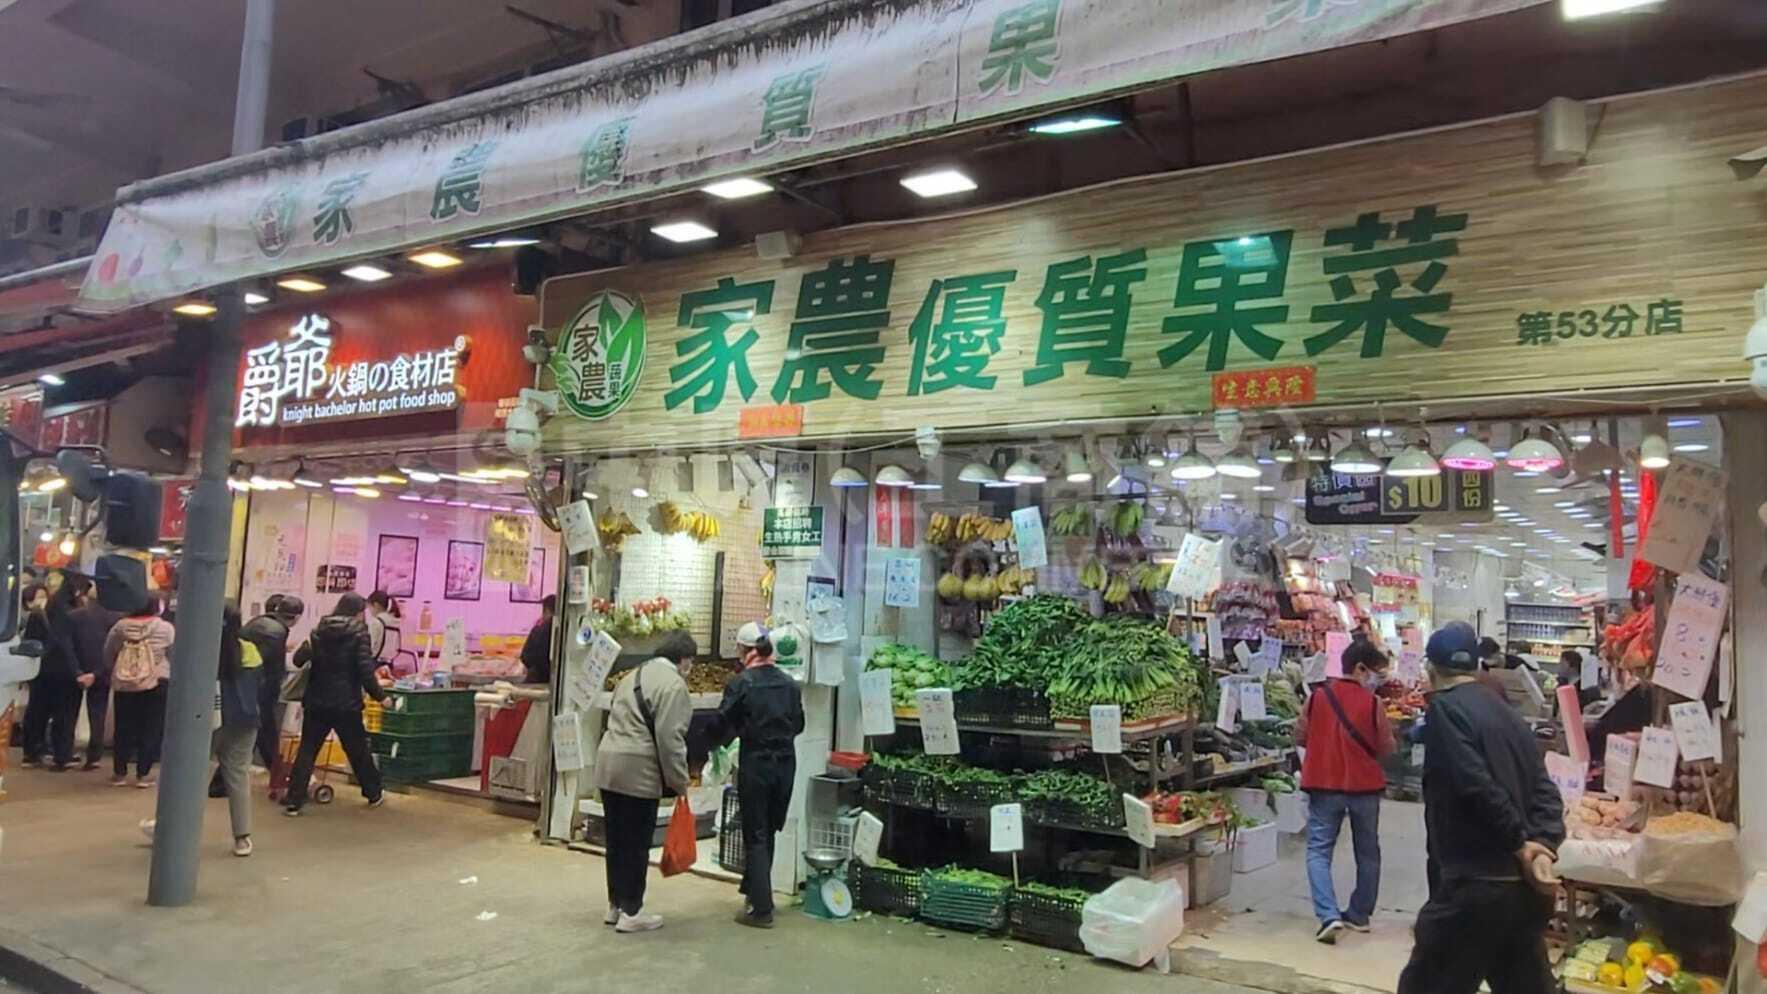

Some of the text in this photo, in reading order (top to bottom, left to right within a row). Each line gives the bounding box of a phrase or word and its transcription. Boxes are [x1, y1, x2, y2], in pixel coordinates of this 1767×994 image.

[663, 205, 1468, 415] 家農優質果菜
[1516, 299, 1684, 346] 第53分店
[235, 313, 331, 427] 爵爺
[326, 351, 457, 399] 火鍋の食材店
[571, 323, 606, 401] 家農
[283, 390, 455, 423] knight bachelor hot pot food shop
[1388, 474, 1442, 509] $10
